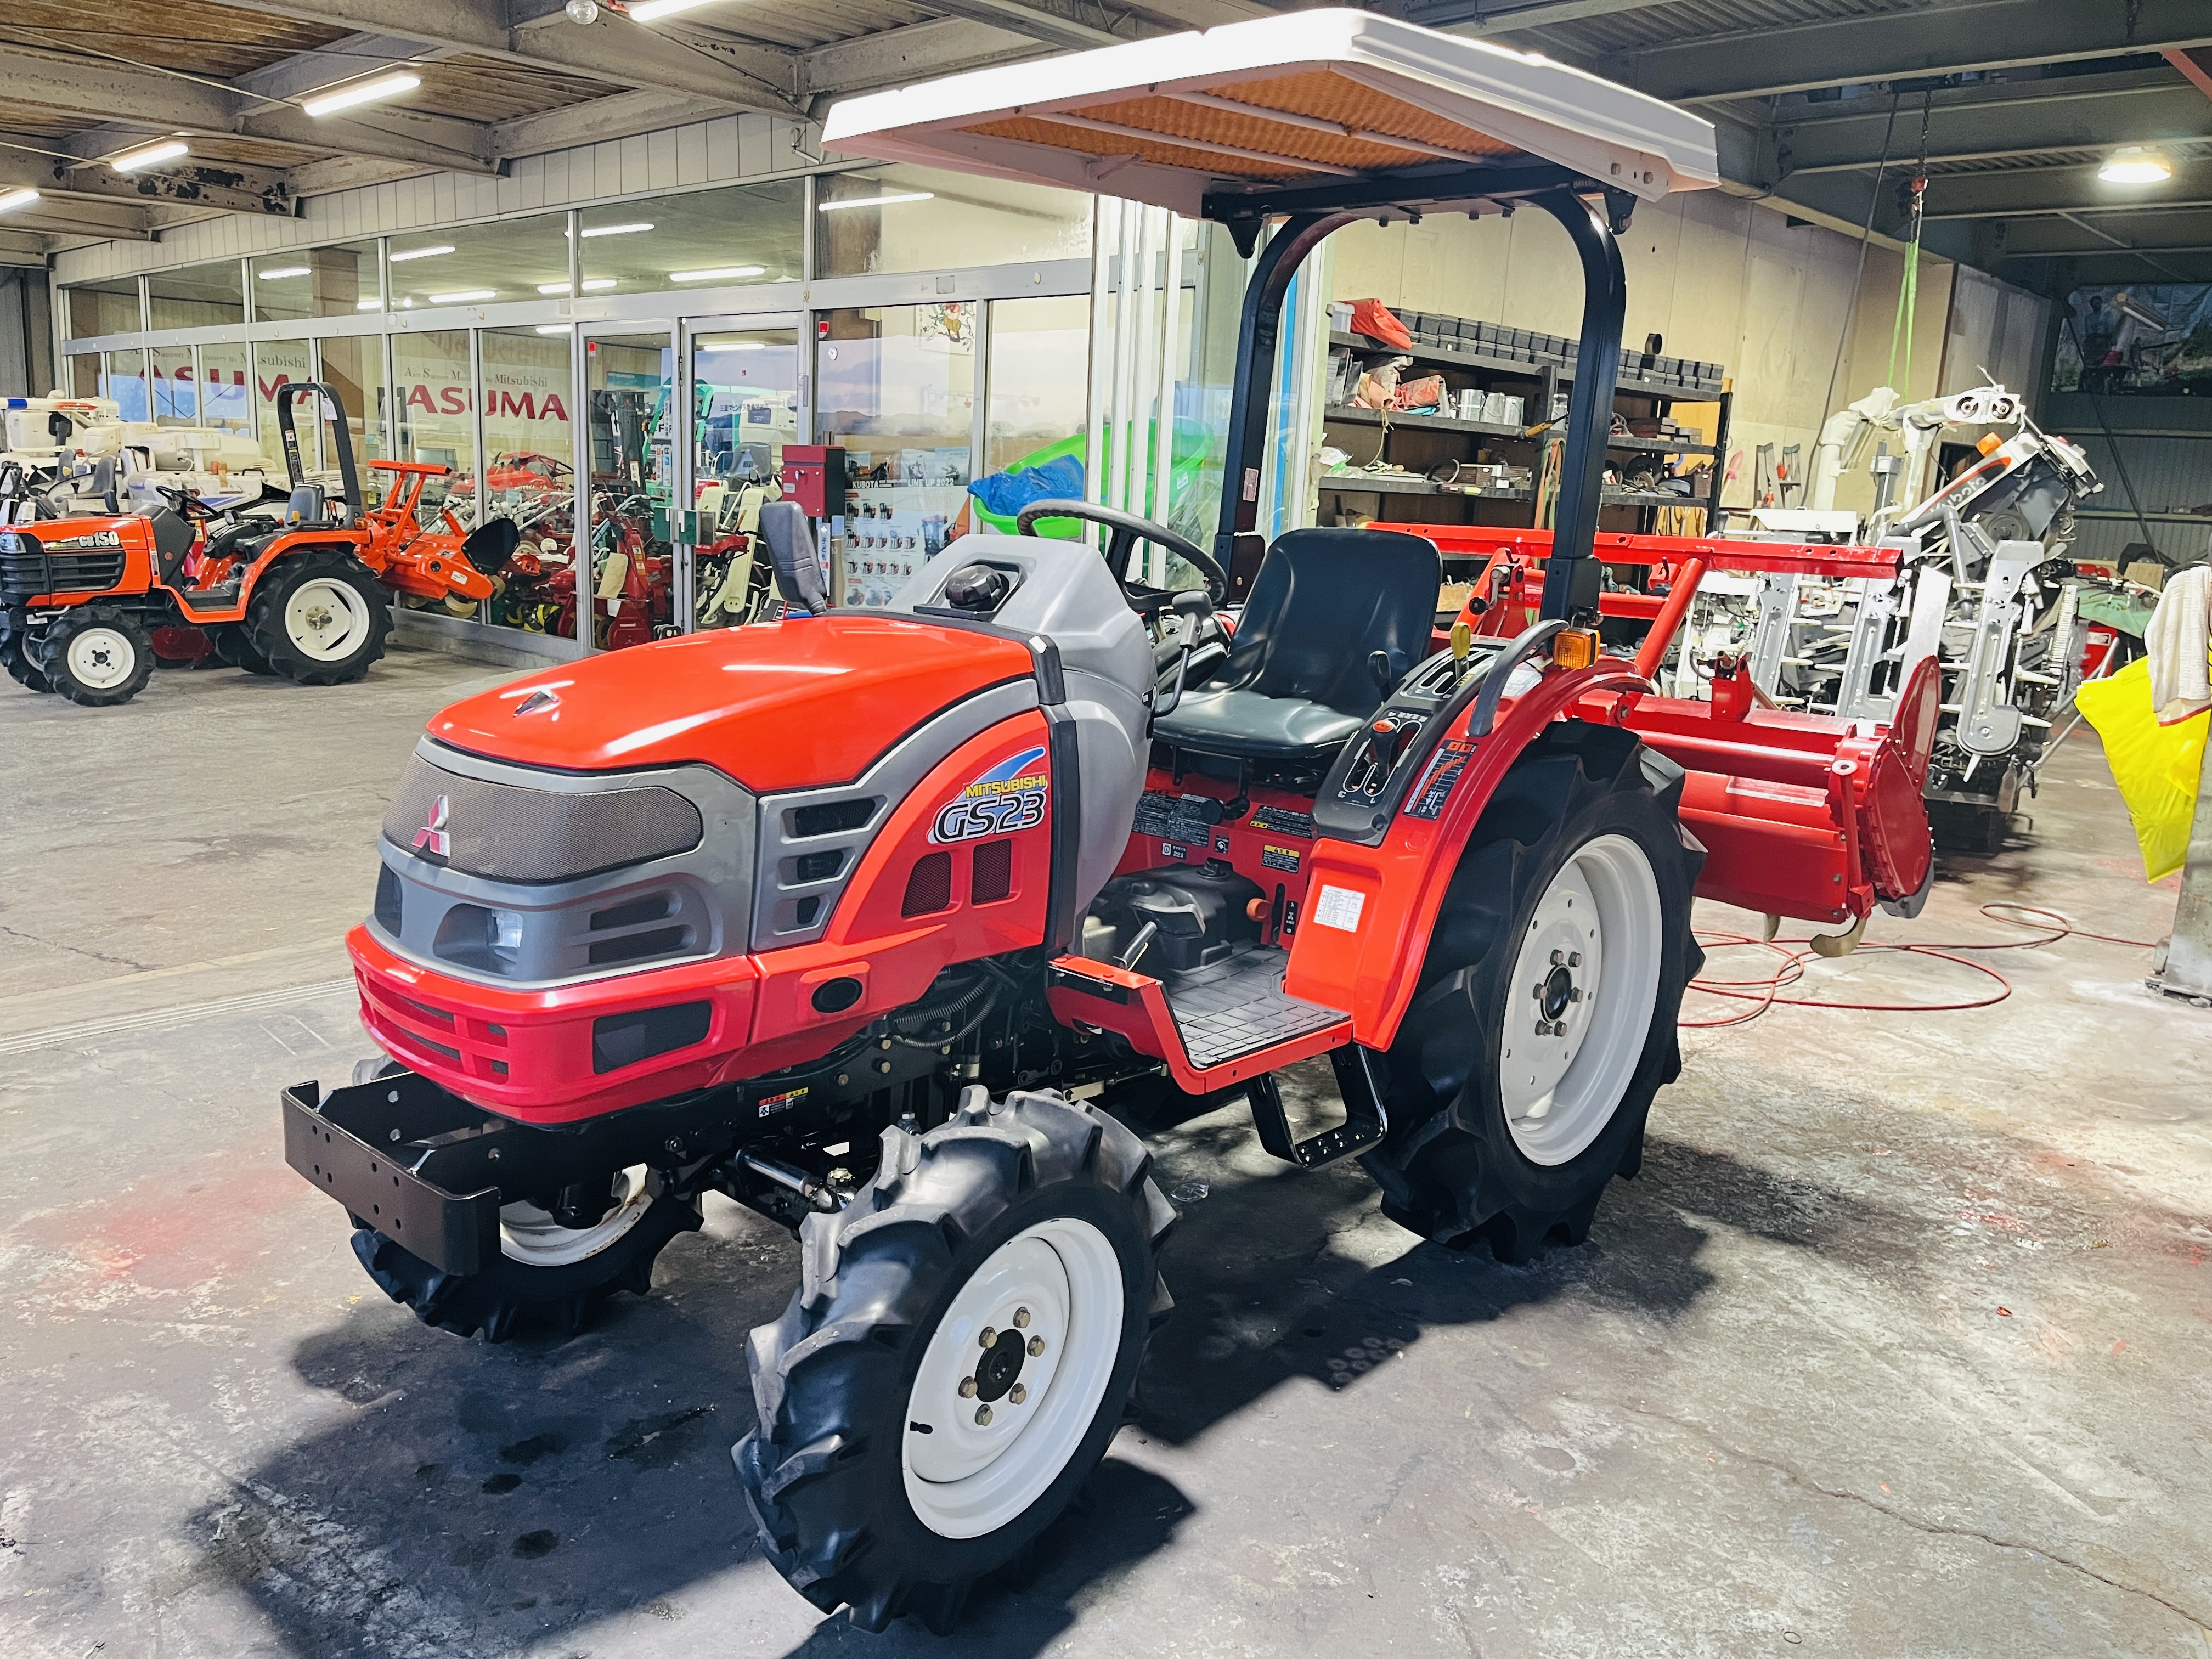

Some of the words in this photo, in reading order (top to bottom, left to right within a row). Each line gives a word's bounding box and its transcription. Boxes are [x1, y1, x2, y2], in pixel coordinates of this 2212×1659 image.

[495, 374, 548, 388] Mitsubishi
[852, 480, 879, 489] KUBOTA
[907, 479, 924, 488] LINE
[925, 479, 935, 487] UP
[936, 478, 955, 487] 2022
[966, 775, 1046, 799] MITSUBISHI
[934, 791, 1047, 844] GS23
